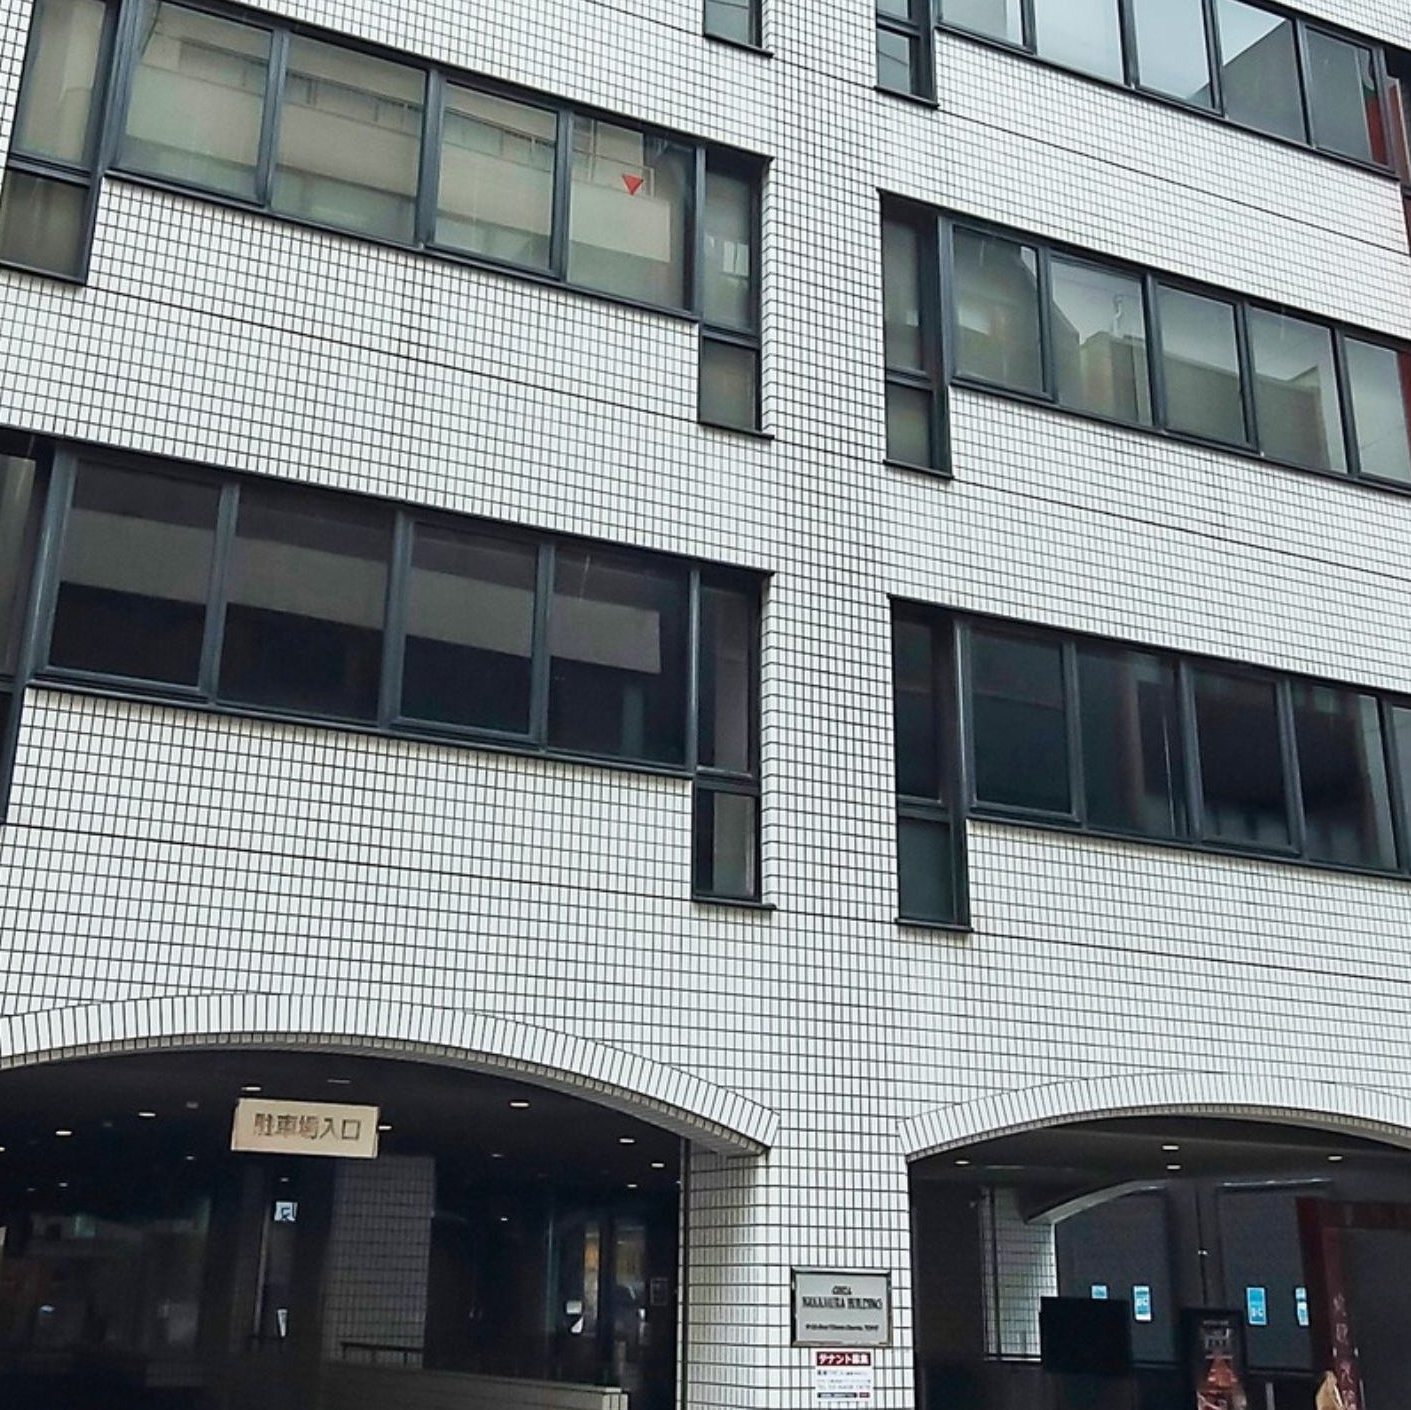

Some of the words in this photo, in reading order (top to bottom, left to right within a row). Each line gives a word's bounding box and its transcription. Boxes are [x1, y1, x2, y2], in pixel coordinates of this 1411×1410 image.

[254, 1113, 361, 1140] 駐車場入口
